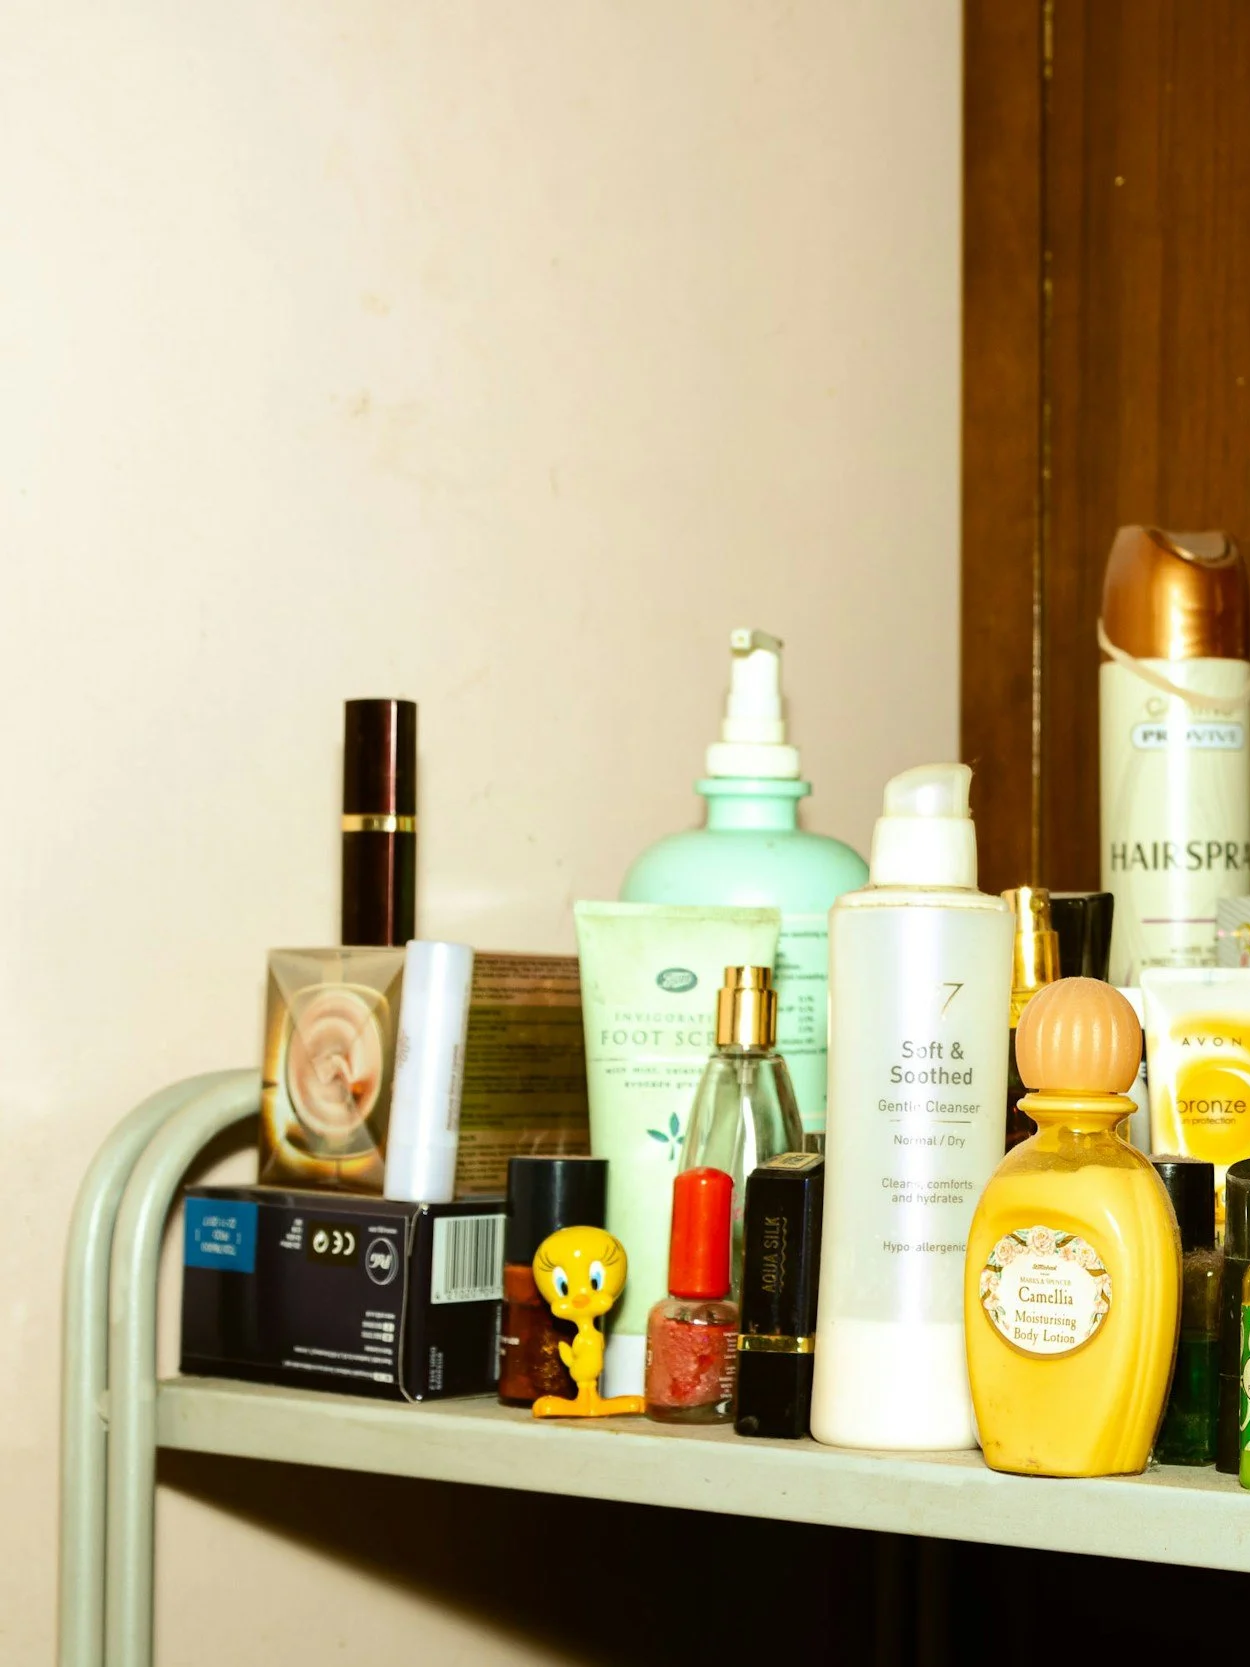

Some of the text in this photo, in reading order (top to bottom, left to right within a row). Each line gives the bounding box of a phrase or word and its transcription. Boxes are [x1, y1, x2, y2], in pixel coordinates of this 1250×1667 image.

[1111, 840, 1177, 871] HAIR
[614, 1012, 713, 1024] INVIGORATI
[601, 1030, 717, 1046] FOOT SCR
[1182, 1037, 1242, 1047] AVON
[902, 1041, 964, 1060] Soft &
[890, 1066, 973, 1085] Soothed
[926, 1100, 980, 1114] Cleanser
[1192, 1117, 1236, 1126] protection
[947, 1135, 966, 1148] Dry
[927, 1178, 973, 1190] comforts
[892, 1193, 963, 1205] and hydrates
[761, 1216, 780, 1293] AQUA SILK
[1018, 1286, 1073, 1305] Camellia
[1014, 1310, 1077, 1330] Moisturising
[1014, 1327, 1075, 1345] Body Lotion
